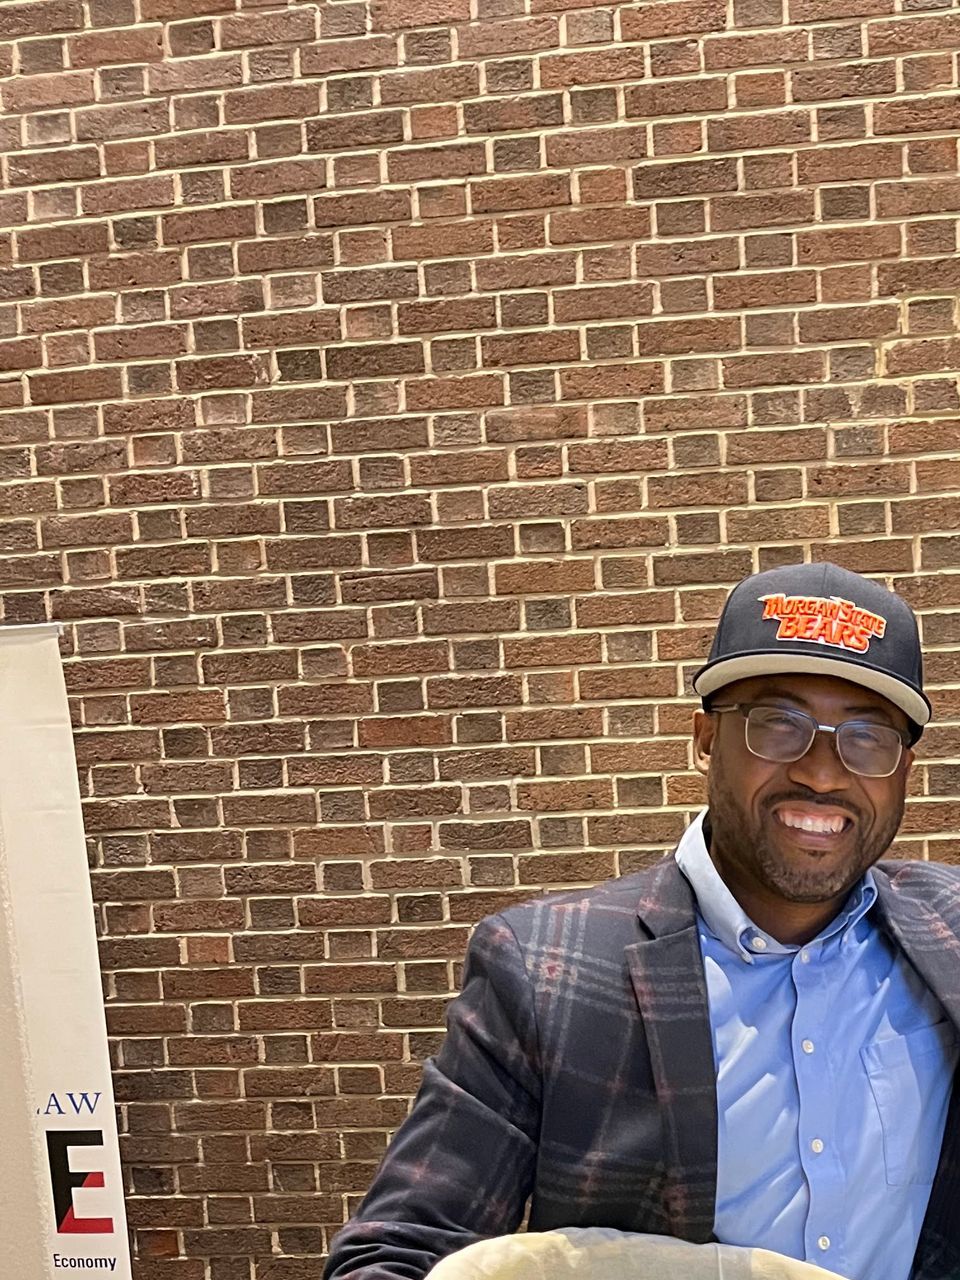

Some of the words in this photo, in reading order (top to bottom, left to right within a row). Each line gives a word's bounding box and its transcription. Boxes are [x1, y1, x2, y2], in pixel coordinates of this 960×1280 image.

[778, 615, 869, 651] BEARS
[37, 1092, 102, 1115] AW
[46, 1130, 114, 1233] E
[53, 1254, 117, 1271] Economy
